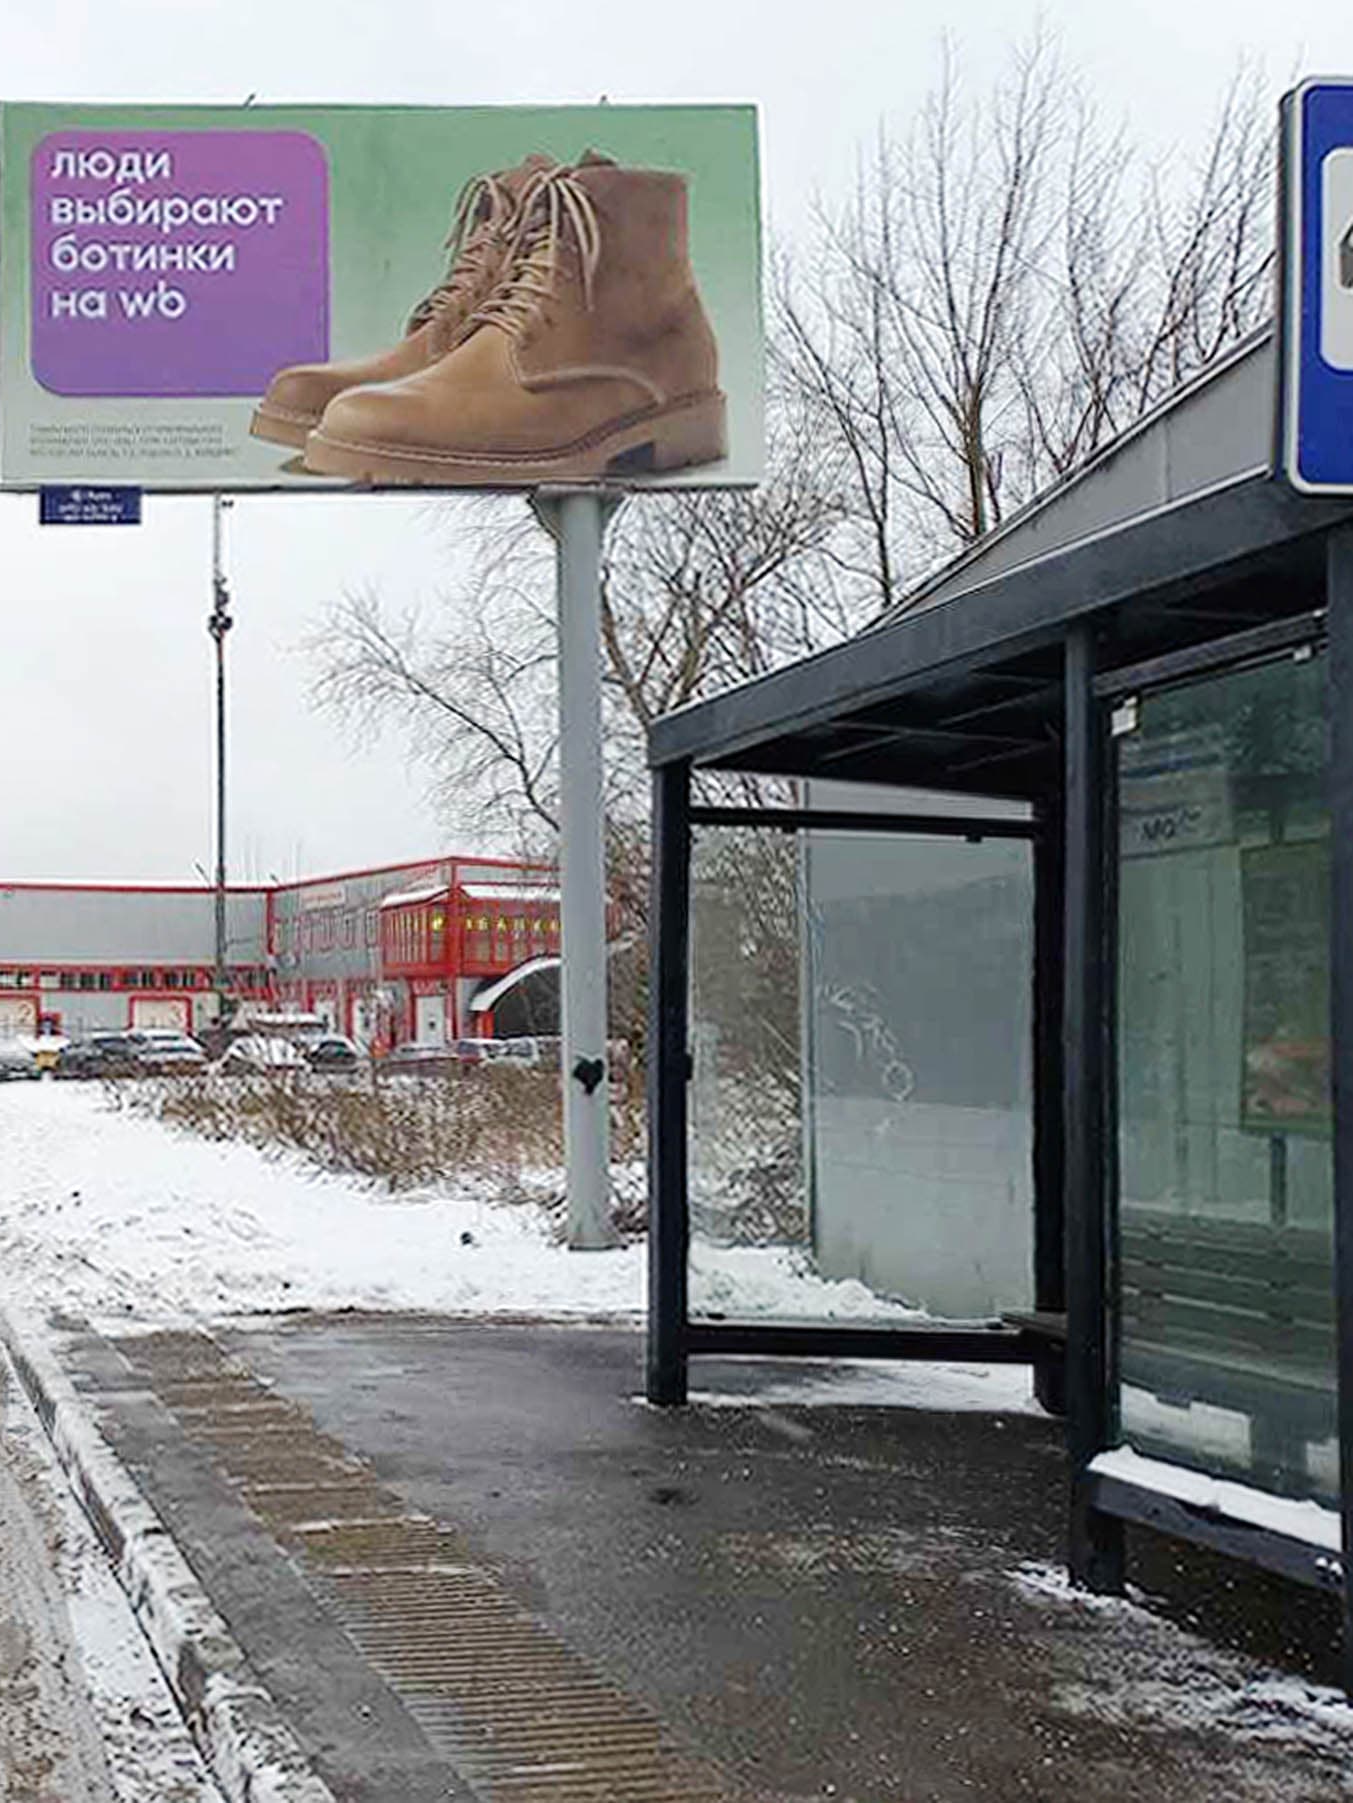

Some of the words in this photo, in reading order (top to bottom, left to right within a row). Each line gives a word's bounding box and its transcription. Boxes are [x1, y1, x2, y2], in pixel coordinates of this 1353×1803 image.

[50, 151, 171, 184] люди
[50, 188, 283, 233] выбирают
[50, 233, 236, 272] ботинки
[50, 289, 107, 318] на
[119, 279, 187, 318] wb
